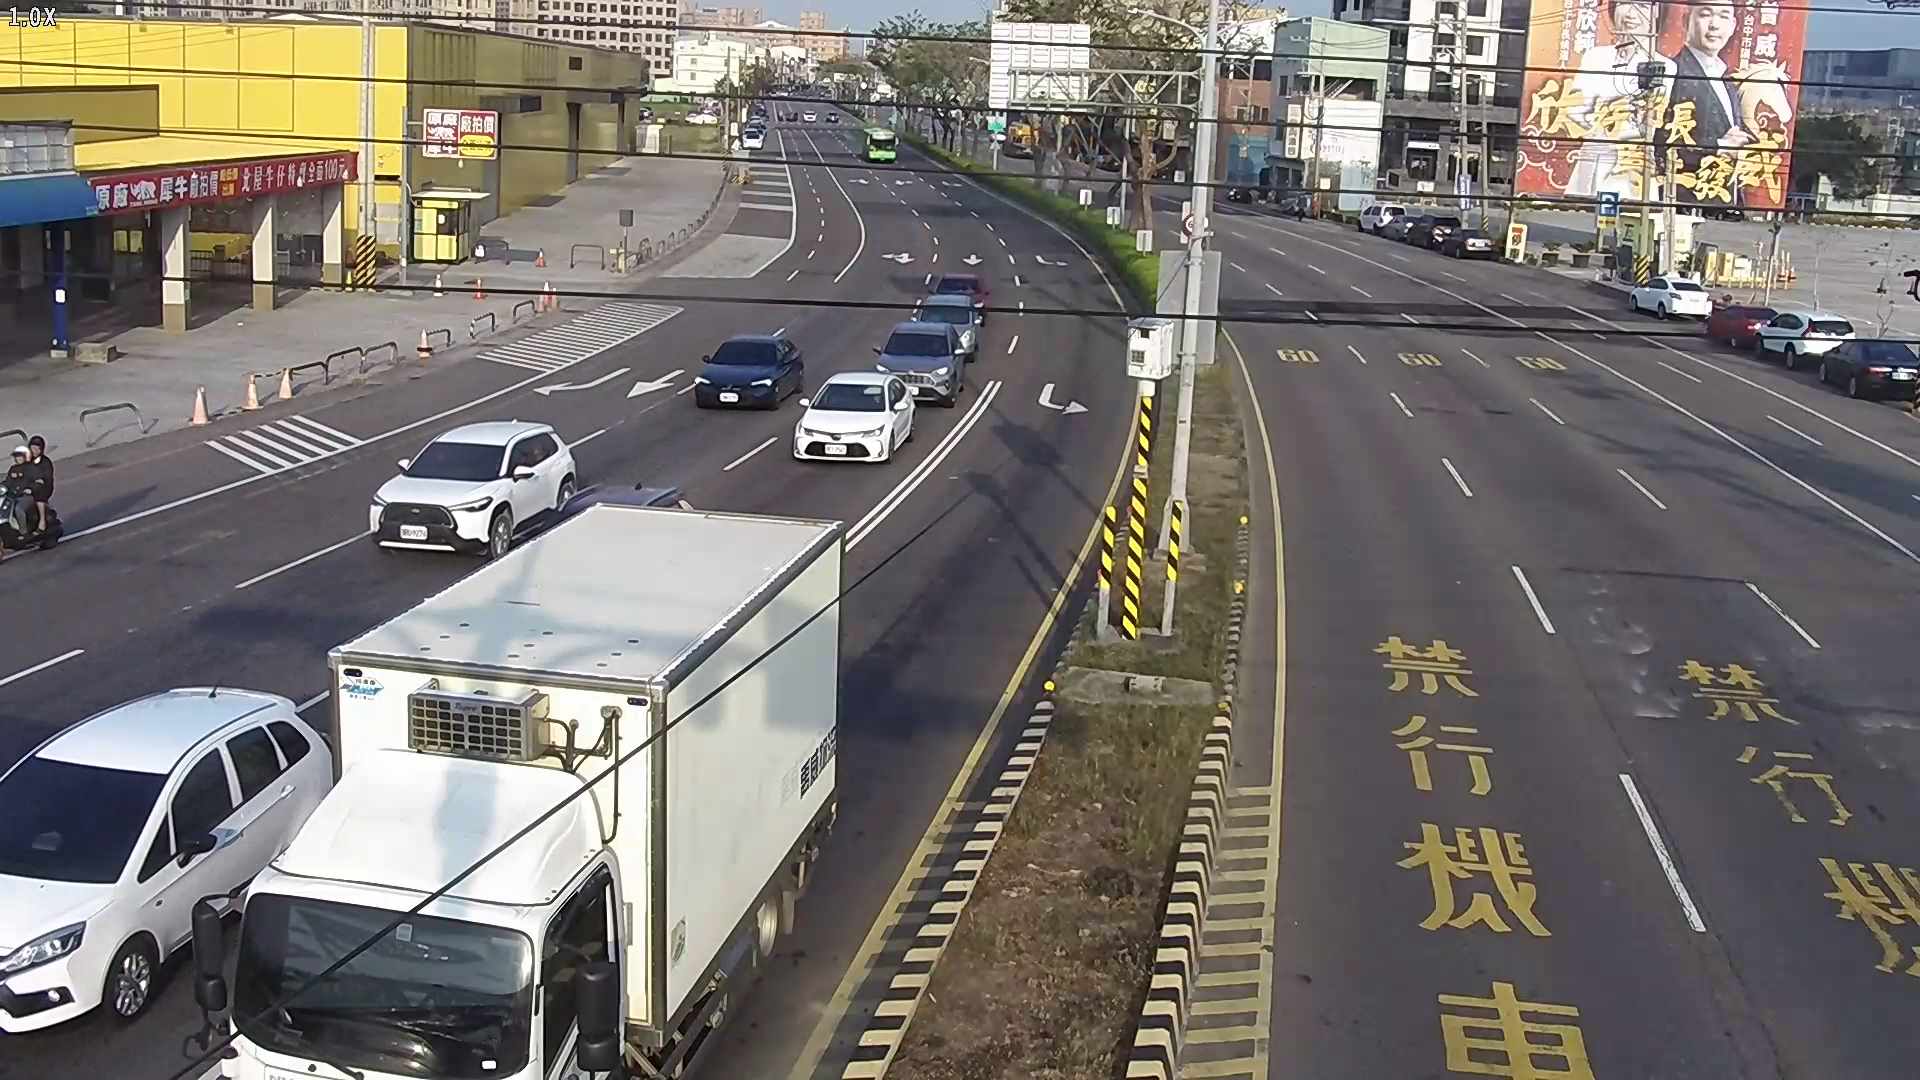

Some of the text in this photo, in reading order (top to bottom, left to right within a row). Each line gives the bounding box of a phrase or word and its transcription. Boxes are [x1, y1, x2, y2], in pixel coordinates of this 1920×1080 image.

[1276, 348, 1320, 364] 60
[1397, 352, 1442, 367] 60
[1372, 635, 1596, 1080] 禁行機車
